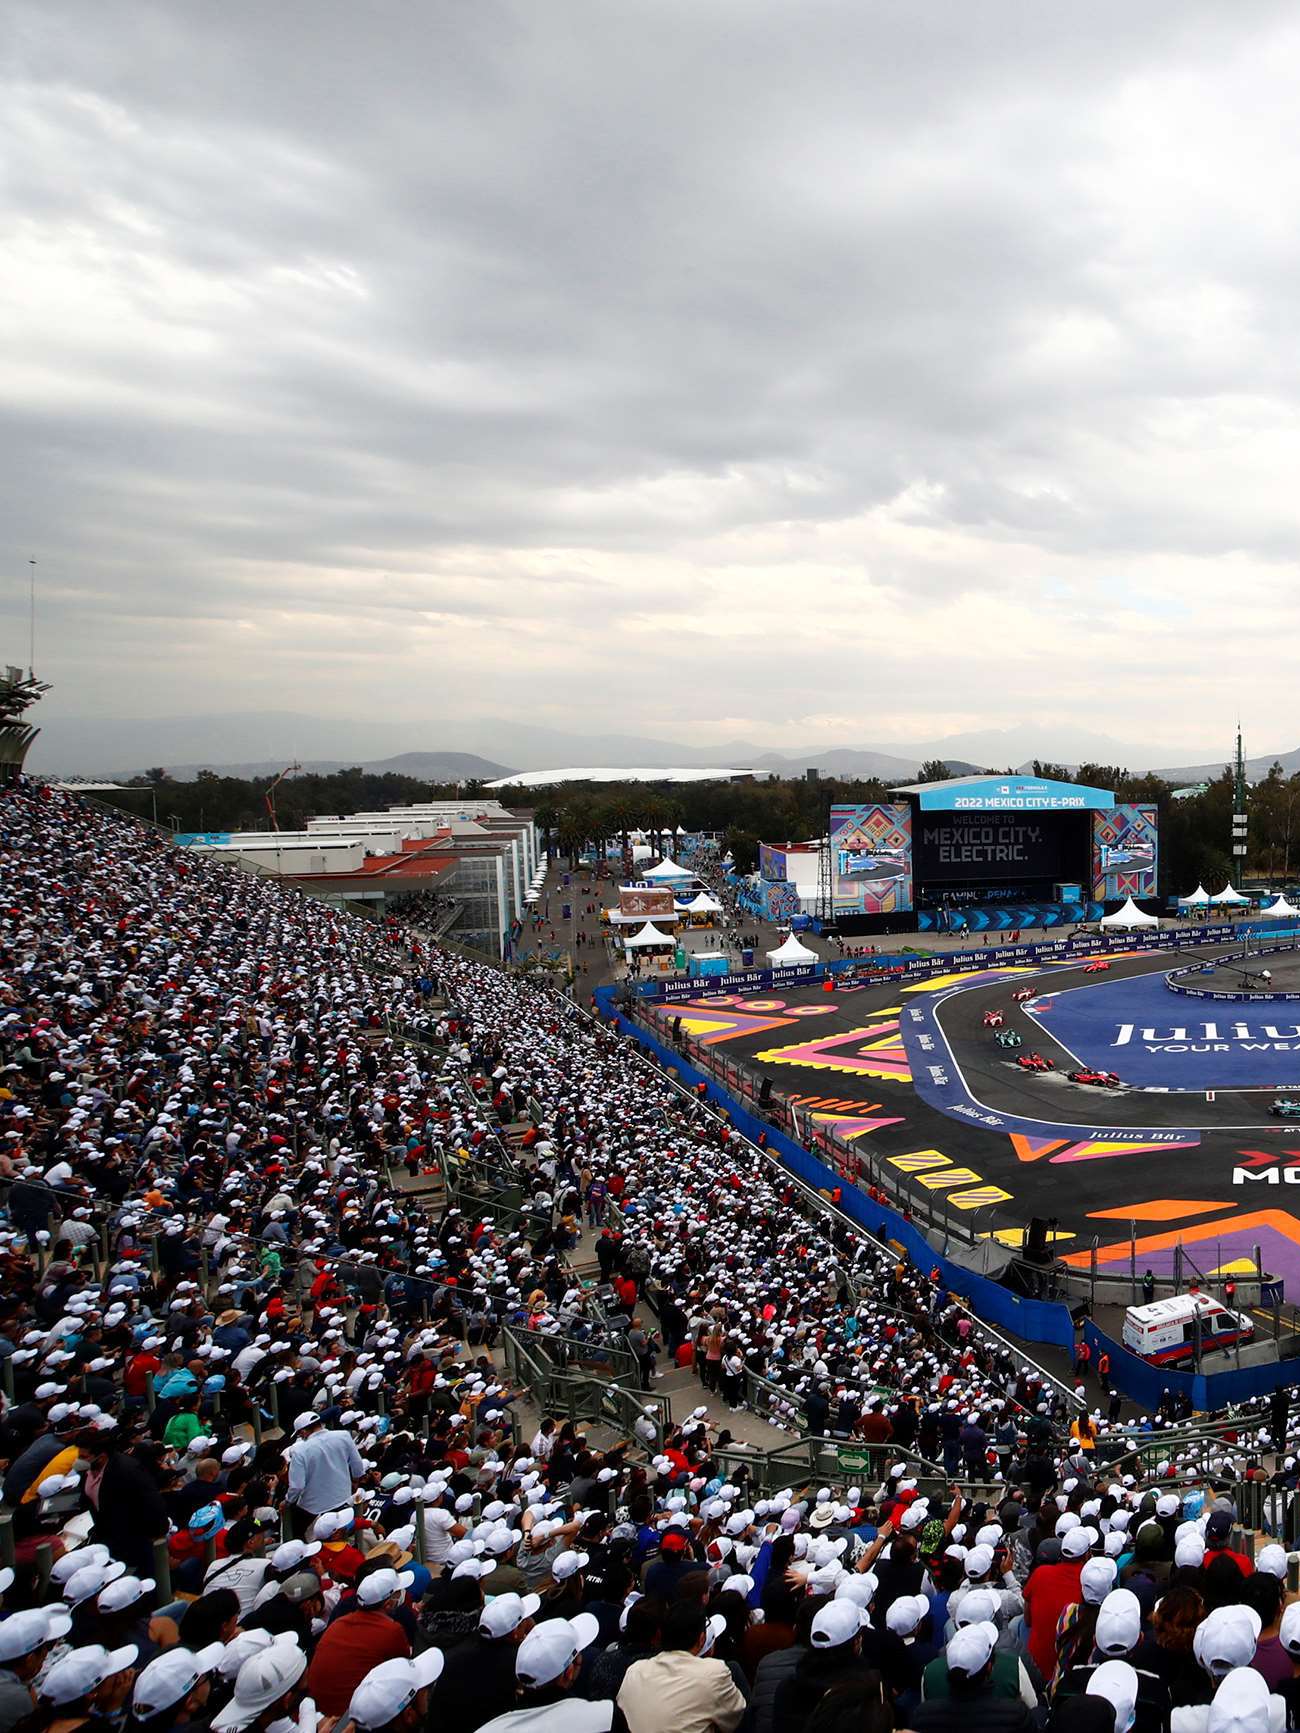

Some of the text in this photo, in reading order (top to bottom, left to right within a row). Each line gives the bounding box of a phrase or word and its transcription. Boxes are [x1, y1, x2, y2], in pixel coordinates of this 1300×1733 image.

[955, 797, 1086, 808] 2022 MEXICO CITY E-PRIX
[952, 816, 1015, 824] WELCOME TO
[923, 826, 1043, 845] MEXICO CITY.
[939, 845, 1029, 862] ELECTRIC.
[1072, 942, 1090, 950] Julius
[1109, 936, 1138, 946] Julius Bär
[995, 948, 1028, 960] Julius Bär
[1035, 943, 1066, 954] Julius Bär
[909, 958, 944, 969] Julius Bär
[952, 954, 988, 964] Julius Bär
[720, 973, 762, 986] Julius Bär
[772, 968, 812, 980] Julius Bär
[664, 980, 710, 992] Julius Bär
[1144, 1045, 1231, 1054] YOUR
[946, 1104, 1004, 1126] Julius Bär
[1089, 1131, 1144, 1140] Julius
